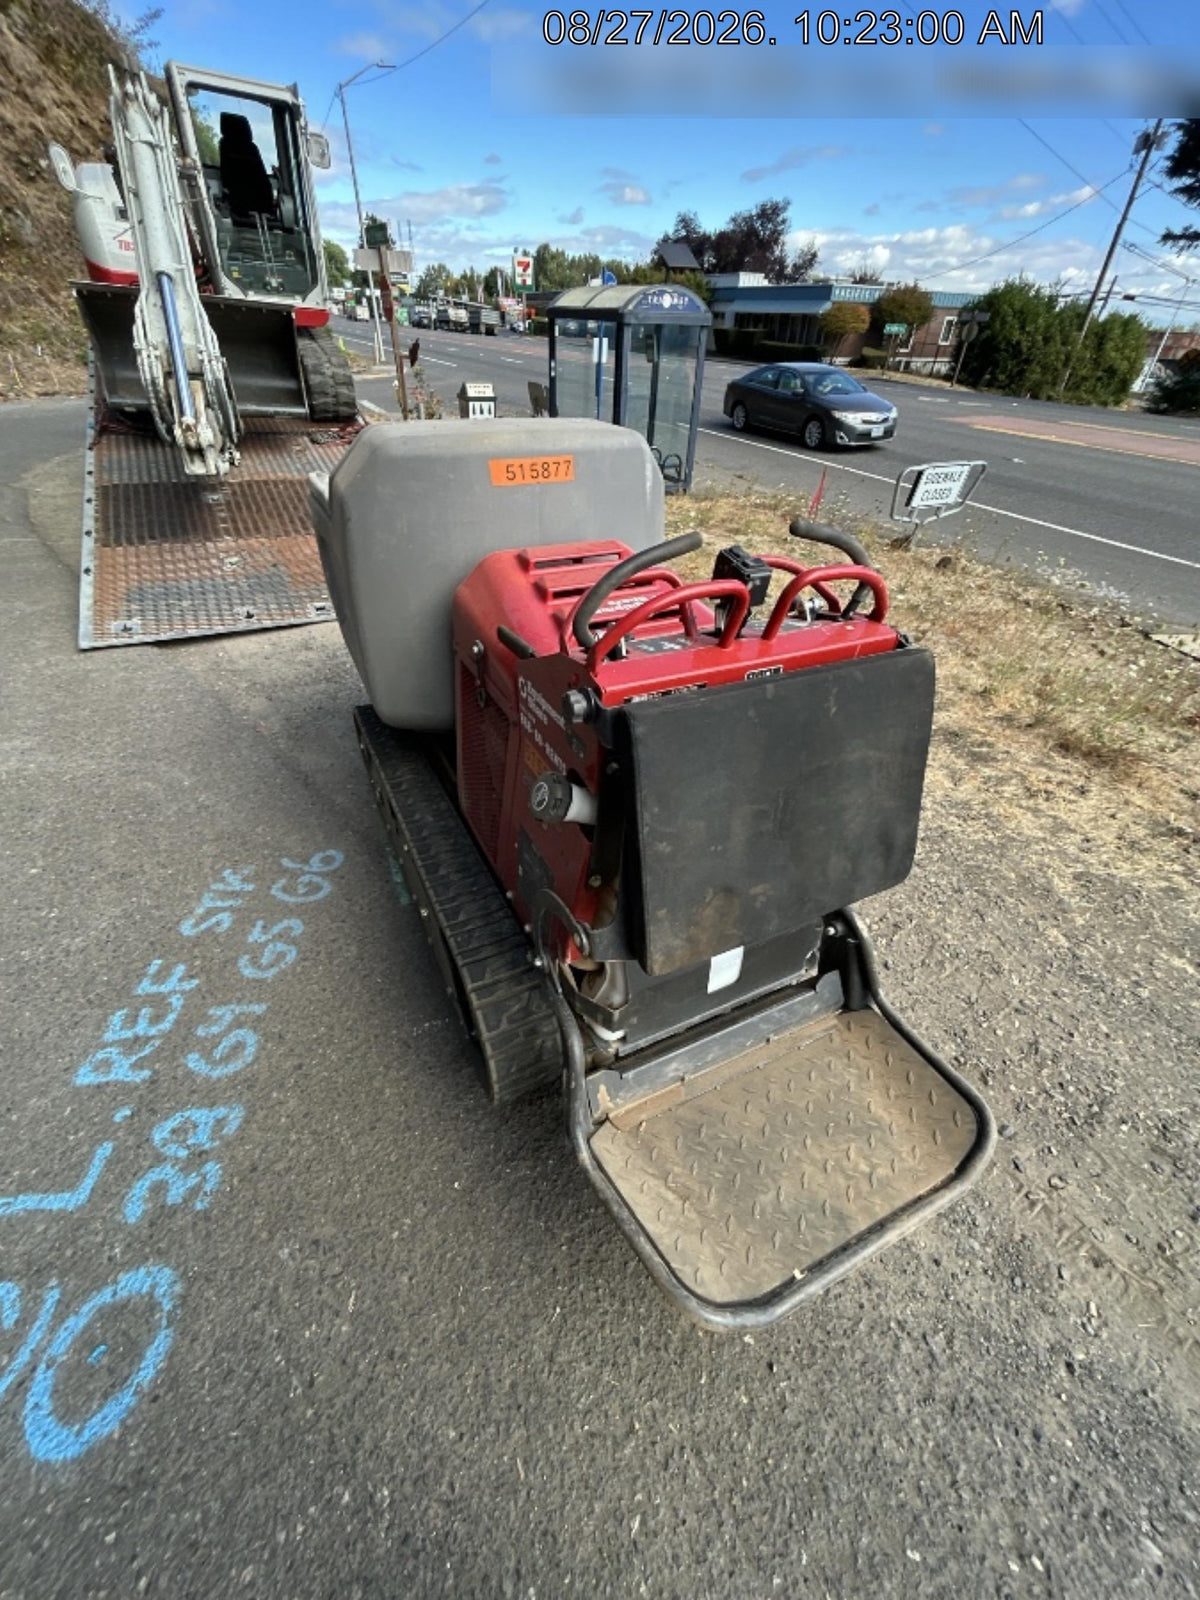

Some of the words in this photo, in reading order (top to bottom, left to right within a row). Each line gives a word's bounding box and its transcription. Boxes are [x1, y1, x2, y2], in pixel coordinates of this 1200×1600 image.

[505, 460, 572, 481] 515877
[924, 471, 965, 485] SIDEWALK
[920, 487, 953, 502] CLOSED
[70, 958, 200, 1088] REF
